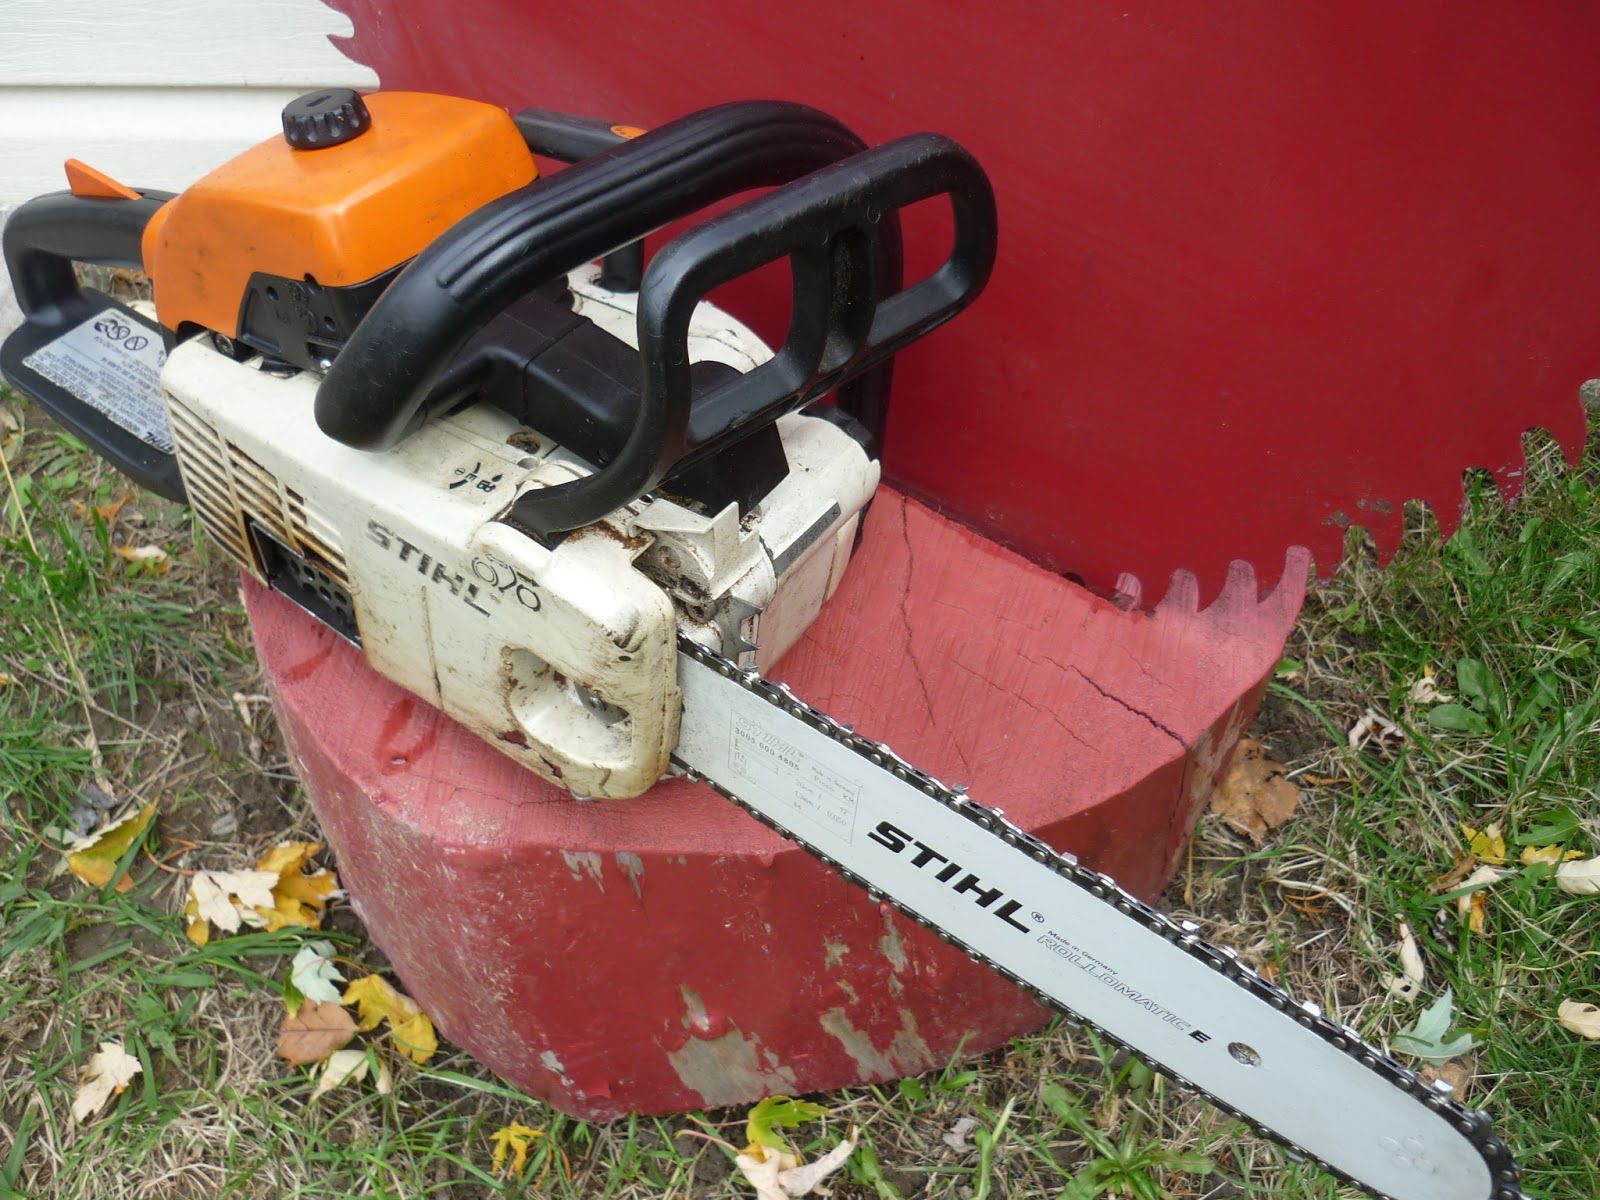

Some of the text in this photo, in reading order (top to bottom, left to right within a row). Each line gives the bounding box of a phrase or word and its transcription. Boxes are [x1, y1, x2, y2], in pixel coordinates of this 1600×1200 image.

[366, 518, 491, 618] STIHL
[734, 727, 800, 771] 3005 000 4805
[1047, 930, 1071, 946] Made
[1081, 951, 1118, 975] Germany
[1036, 934, 1212, 1044] ROLLOMATIC E
